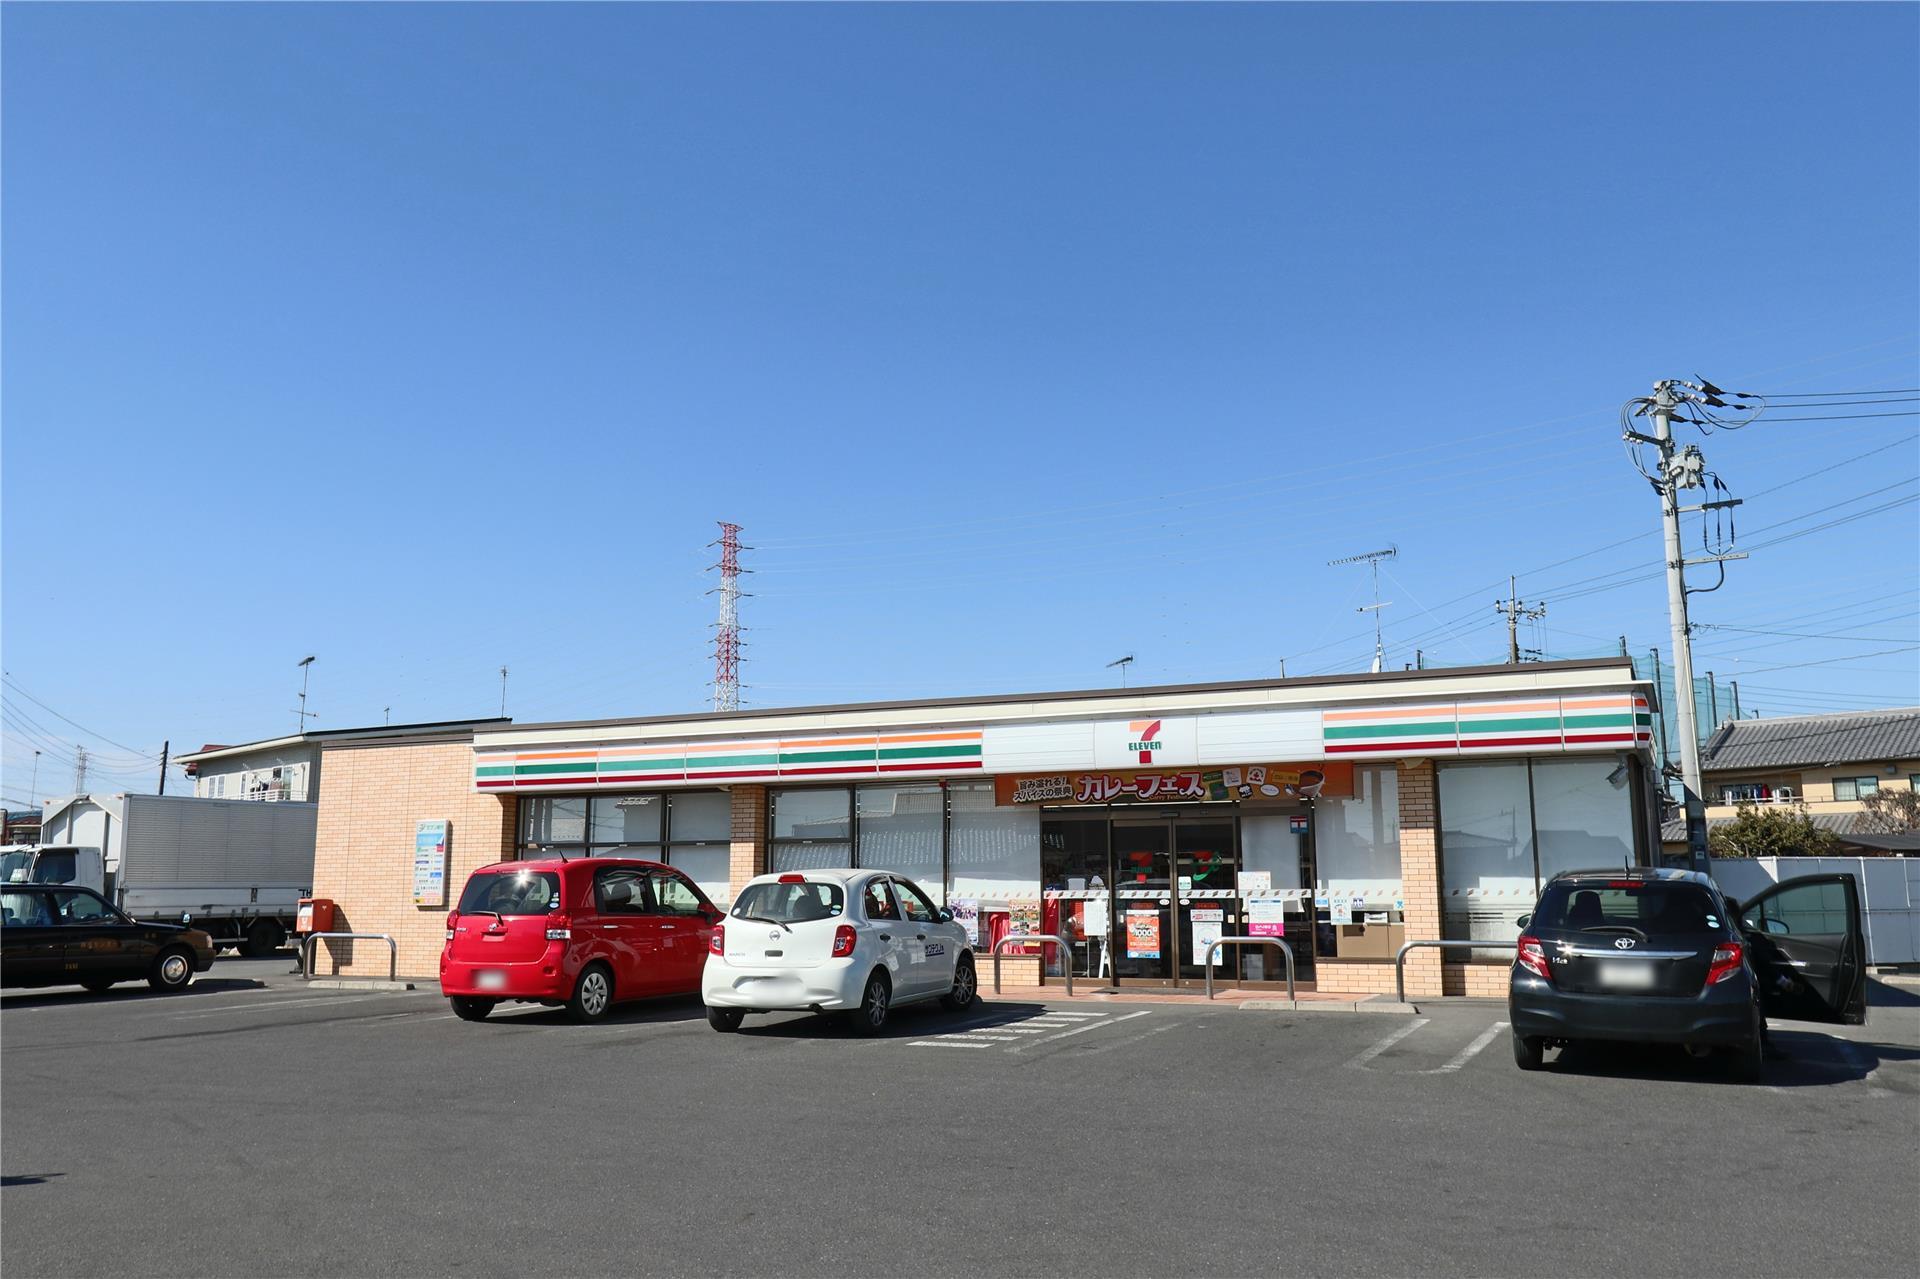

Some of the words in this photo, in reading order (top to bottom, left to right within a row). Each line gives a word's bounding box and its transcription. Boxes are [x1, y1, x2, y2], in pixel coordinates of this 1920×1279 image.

[1076, 772, 1205, 802] カレーフェス
